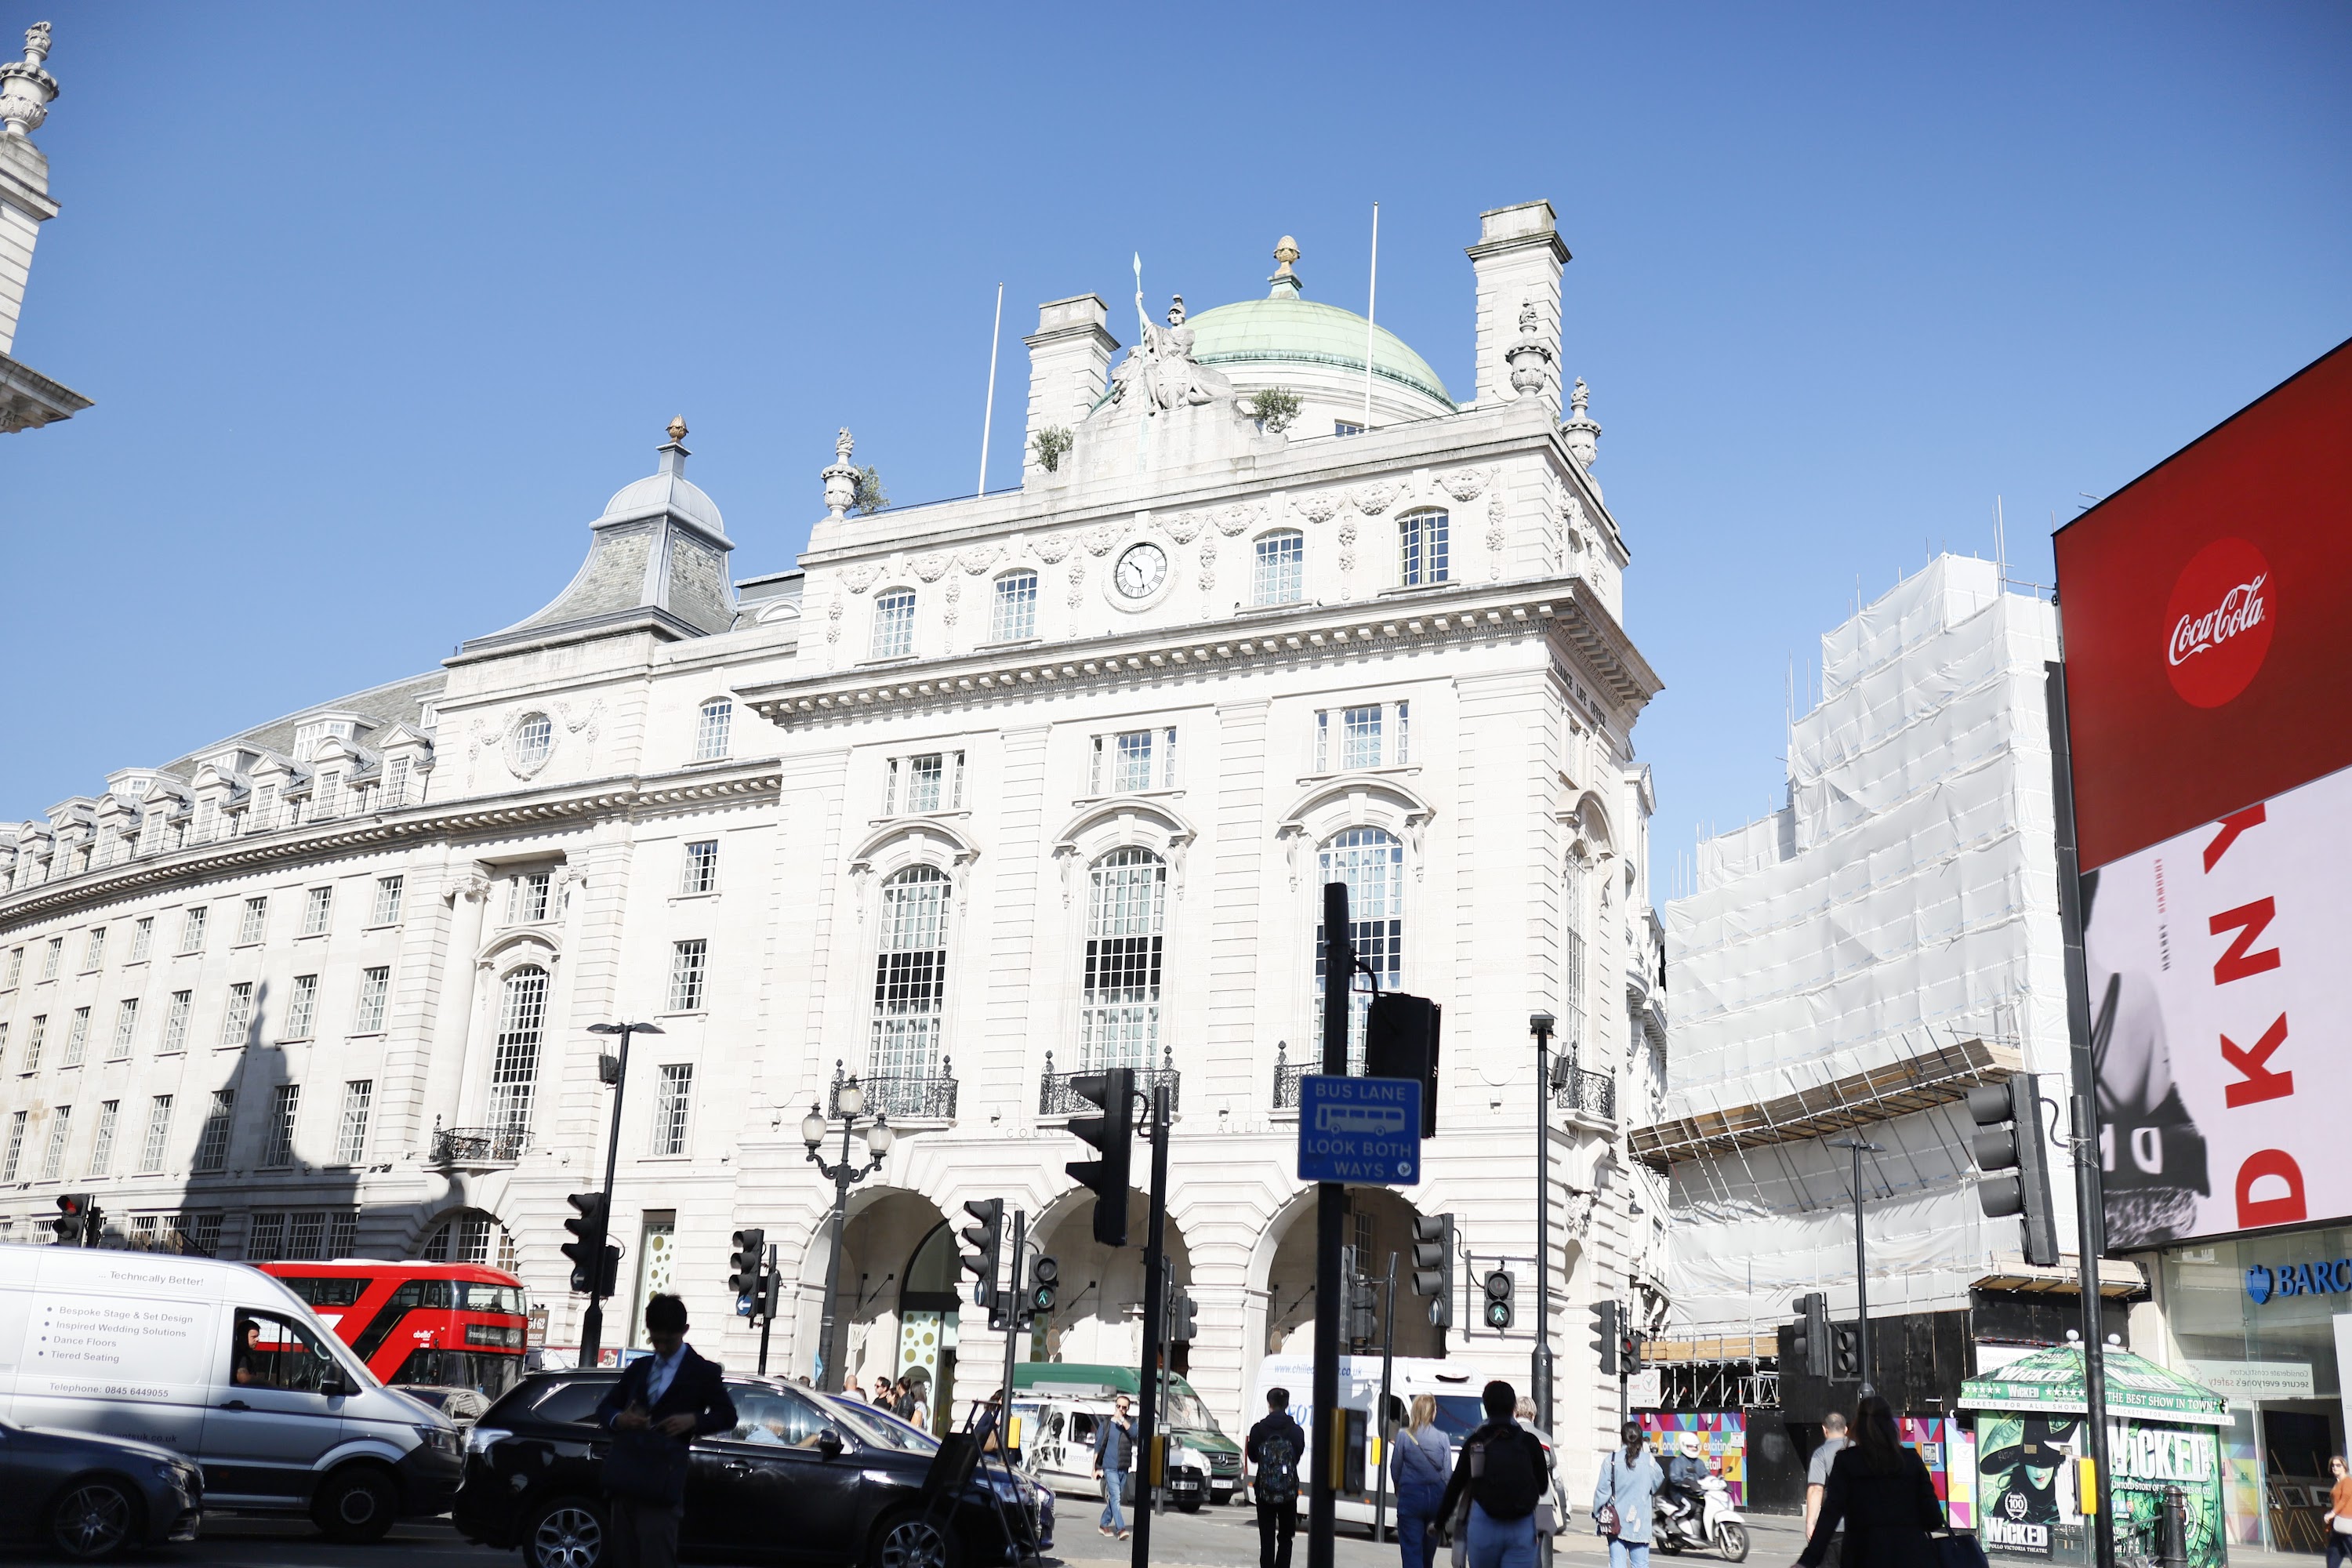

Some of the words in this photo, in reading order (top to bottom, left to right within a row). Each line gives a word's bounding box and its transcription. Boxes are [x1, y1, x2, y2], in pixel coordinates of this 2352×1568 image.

[2169, 571, 2267, 666] Coca-Cola
[1576, 684, 1587, 706] LIFE
[1590, 700, 1606, 728] OFFICE
[1316, 1083, 1352, 1098] BUS
[1359, 1085, 1406, 1102] LANE
[1308, 1139, 1356, 1156] LOOK
[1363, 1142, 1411, 1158] BOTH
[1334, 1161, 1385, 1178] WAYS
[110, 1270, 166, 1285] Technically
[168, 1276, 204, 1286] Better!
[2277, 1258, 2352, 1297] BARC
[60, 1306, 101, 1317] Bespoke
[103, 1309, 131, 1319] Stage
[143, 1312, 158, 1321] Set
[162, 1314, 194, 1324] Design
[56, 1320, 96, 1331] Inspired
[98, 1323, 140, 1336] Wedding
[142, 1327, 187, 1338] Solutions
[53, 1336, 83, 1345] Dance
[86, 1338, 117, 1347] Floors
[506, 1331, 519, 1344] 159
[51, 1350, 82, 1360] Tiered
[83, 1352, 120, 1364] Seating
[50, 1382, 102, 1394] Telephone:
[105, 1386, 127, 1396] 0845
[130, 1388, 169, 1398] 6449055
[2126, 1393, 2147, 1405] BEST
[2148, 1396, 2174, 1407] SHOW
[2176, 1398, 2186, 1408] IN
[1703, 1439, 1732, 1455] exciting
[1068, 1454, 1093, 1463] openreach
[2111, 1480, 2135, 1490] UNTOLD
[2009, 1499, 2024, 1509] 100
